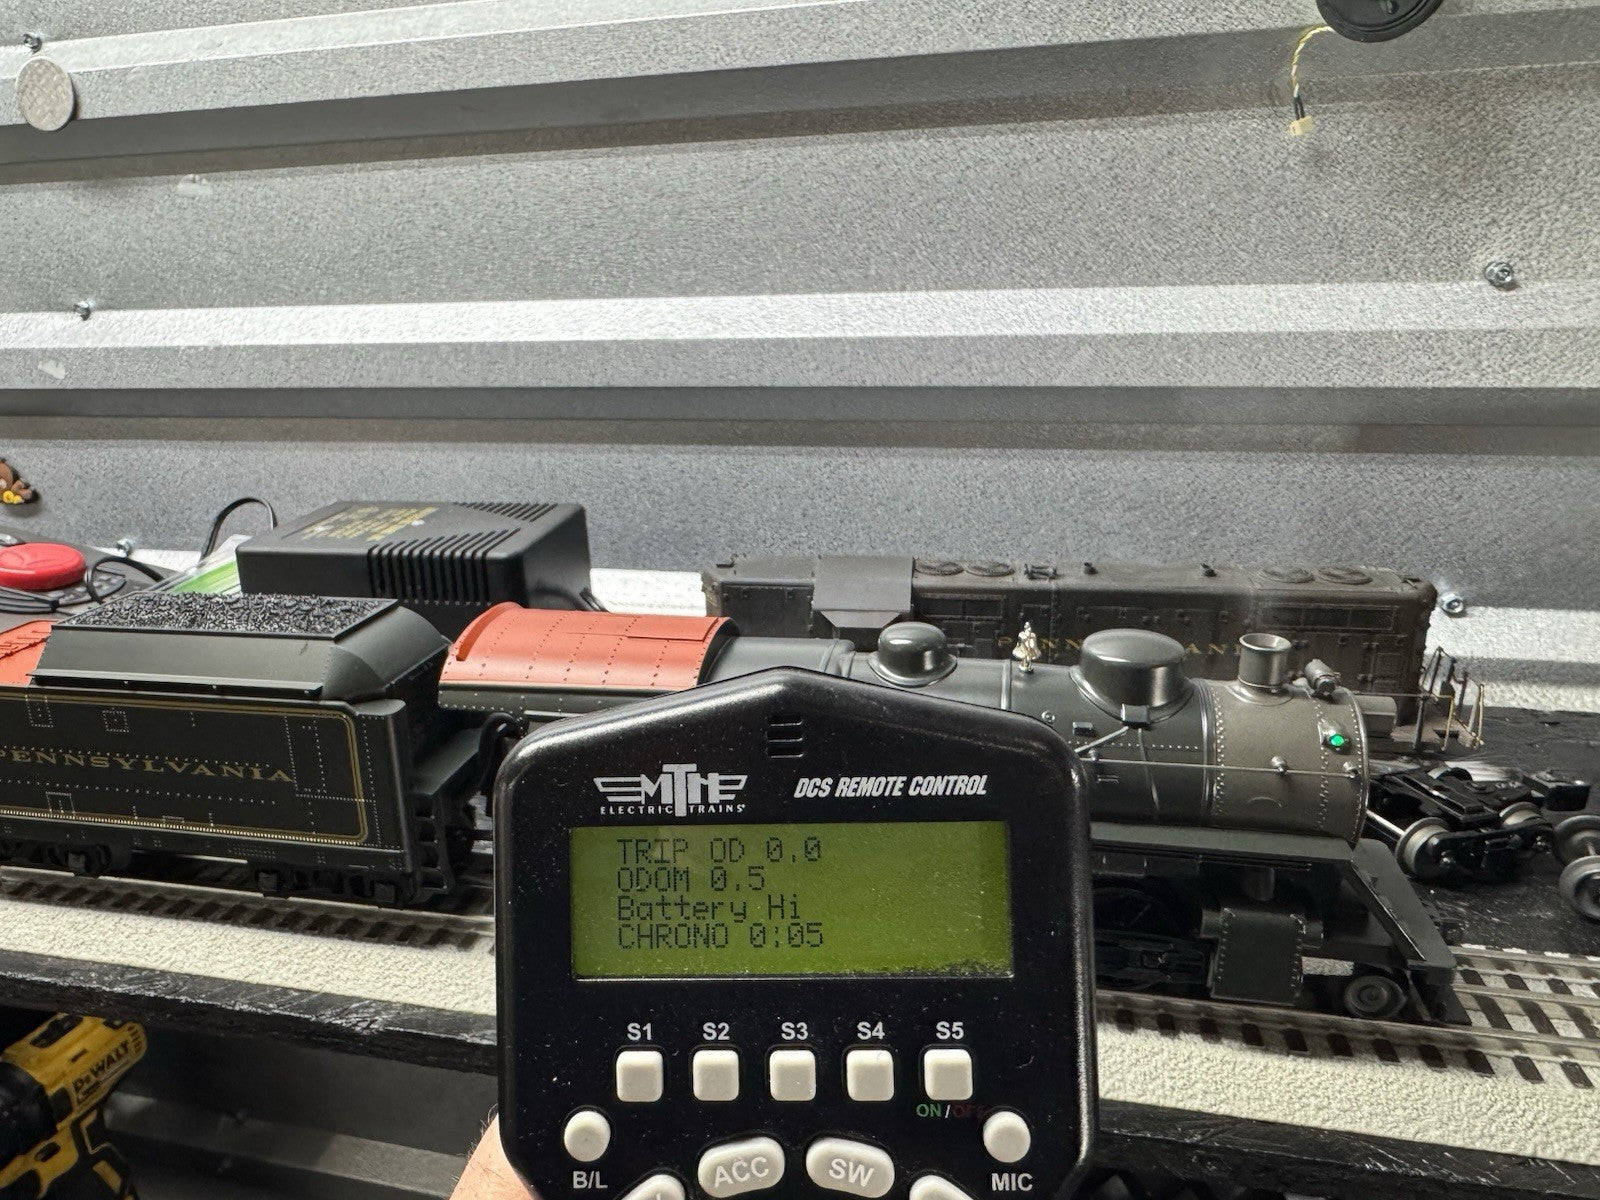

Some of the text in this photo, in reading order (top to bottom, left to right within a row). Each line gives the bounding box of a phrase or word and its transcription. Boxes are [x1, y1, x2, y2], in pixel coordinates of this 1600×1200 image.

[794, 775, 988, 798] DCS REMOTE CONTROL
[600, 805, 674, 815] ELECTRIC
[617, 836, 821, 864] TRIP OD 0.0
[618, 866, 765, 892] ODOM 0.5
[618, 894, 800, 923] Battery Hi
[619, 922, 823, 949] CHRONO 0:05
[627, 1023, 653, 1041] S1
[703, 1022, 730, 1041] S2
[781, 1022, 808, 1040] S3
[857, 1021, 885, 1040] S4
[936, 1021, 964, 1040] S5
[573, 1171, 608, 1189] B/L
[714, 1156, 770, 1188] ACC
[828, 1157, 875, 1187] SW
[991, 1172, 1033, 1191] MIC
